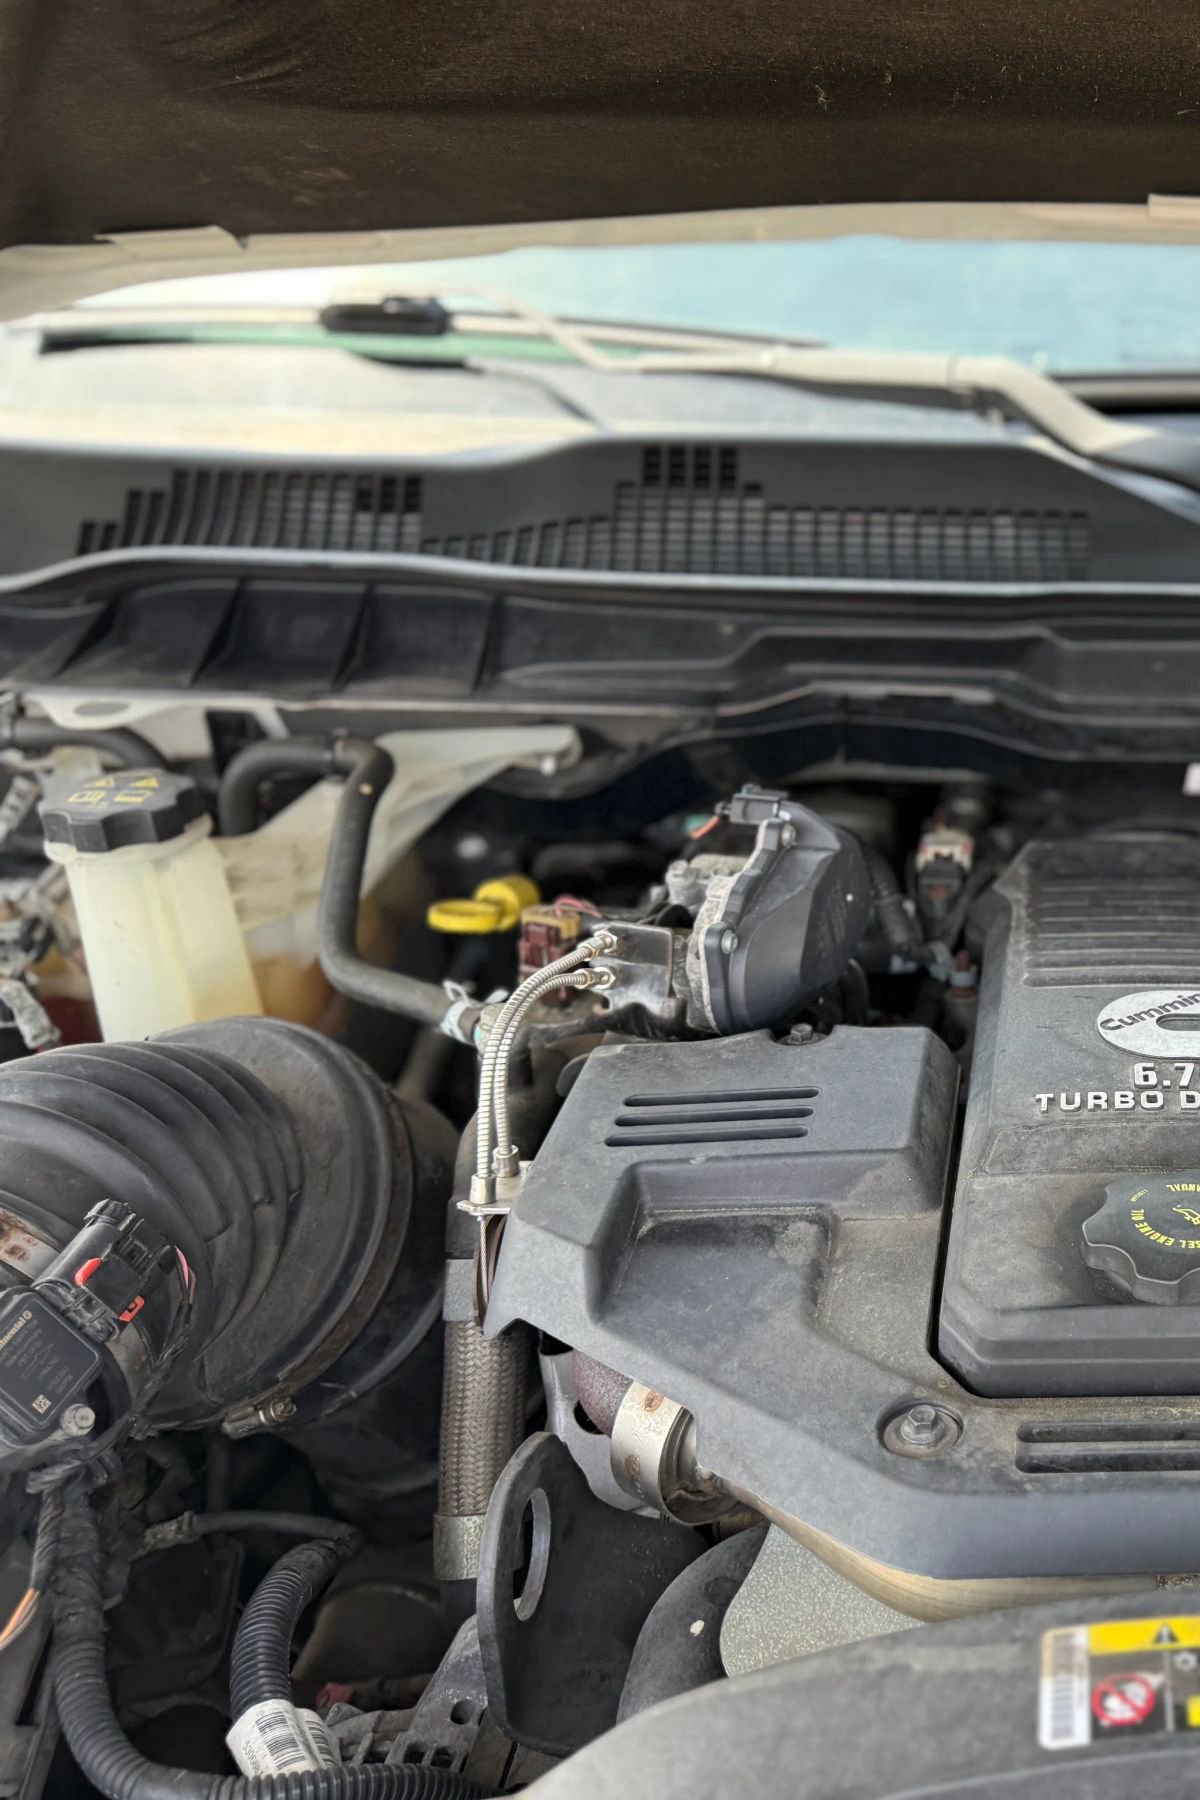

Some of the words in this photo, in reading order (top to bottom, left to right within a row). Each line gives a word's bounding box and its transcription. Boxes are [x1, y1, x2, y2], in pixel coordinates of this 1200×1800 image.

[1035, 1090, 1165, 1113] TURBO
[1130, 1208, 1145, 1221] OIL
[1134, 1221, 1176, 1247] ENGINE
